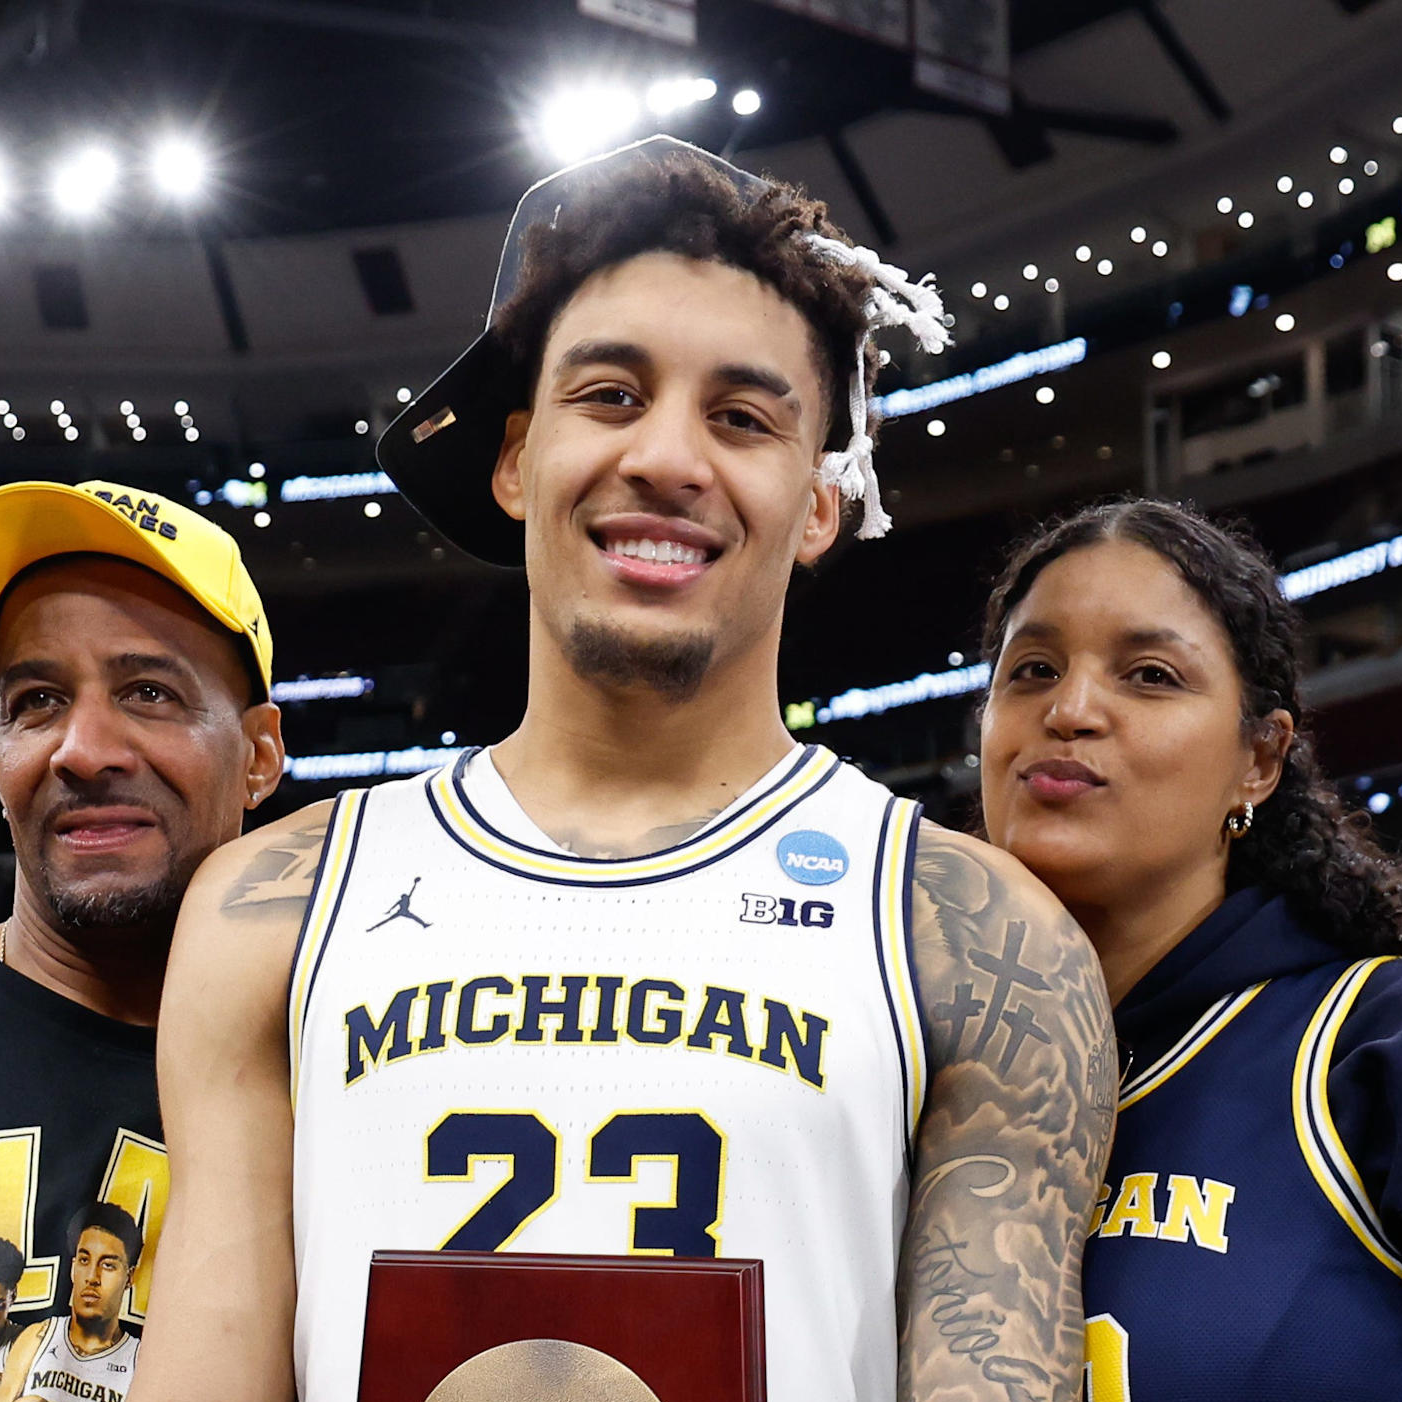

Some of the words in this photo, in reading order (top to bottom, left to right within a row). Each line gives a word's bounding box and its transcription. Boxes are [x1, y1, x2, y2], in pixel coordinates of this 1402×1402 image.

[786, 852, 845, 873] NCAA
[344, 974, 832, 1093] MICHIGAN
[422, 1107, 728, 1259] 23
